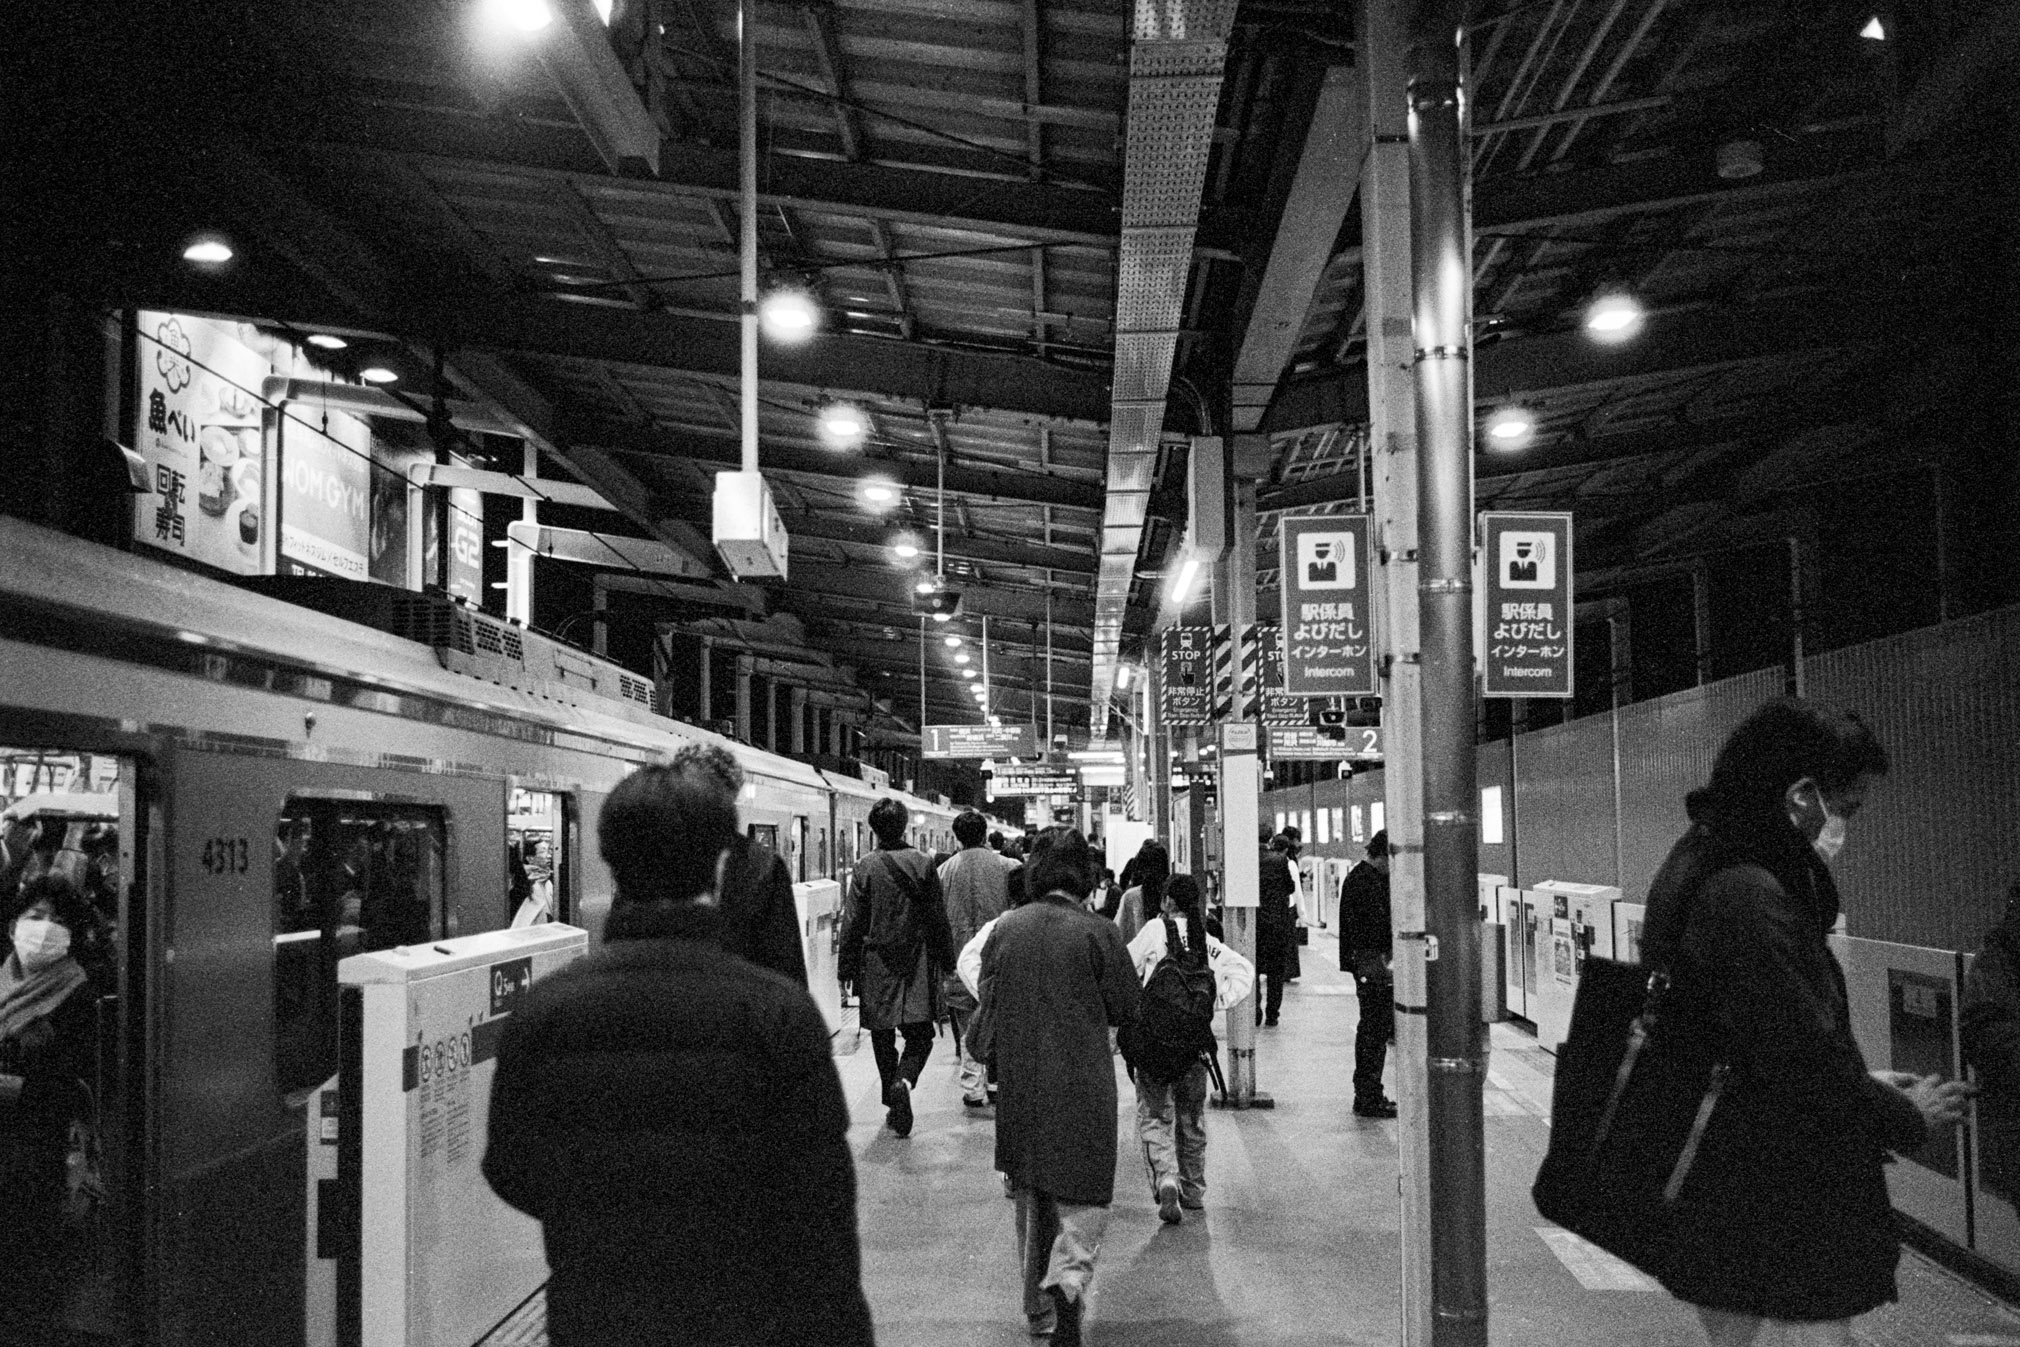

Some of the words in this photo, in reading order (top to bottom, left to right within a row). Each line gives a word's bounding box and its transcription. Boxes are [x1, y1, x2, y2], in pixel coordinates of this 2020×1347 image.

[1301, 603, 1355, 621] 駅係員
[1501, 603, 1553, 621] 駅係員
[1293, 623, 1363, 640] よびだし
[1494, 623, 1561, 640] よびだし
[1172, 650, 1201, 661] STOP
[1291, 645, 1367, 659] インターホン
[1491, 646, 1565, 659] インターホン
[1304, 666, 1355, 678] Intercom
[1503, 666, 1552, 678] Intercom
[1167, 686, 1205, 696] 非常停止
[1265, 687, 1284, 697] 非常
[1172, 696, 1200, 706] ボタン
[1270, 697, 1298, 706] ボタン
[930, 729, 938, 750] 1
[1362, 730, 1378, 753] 2
[202, 838, 248, 875] 4313
